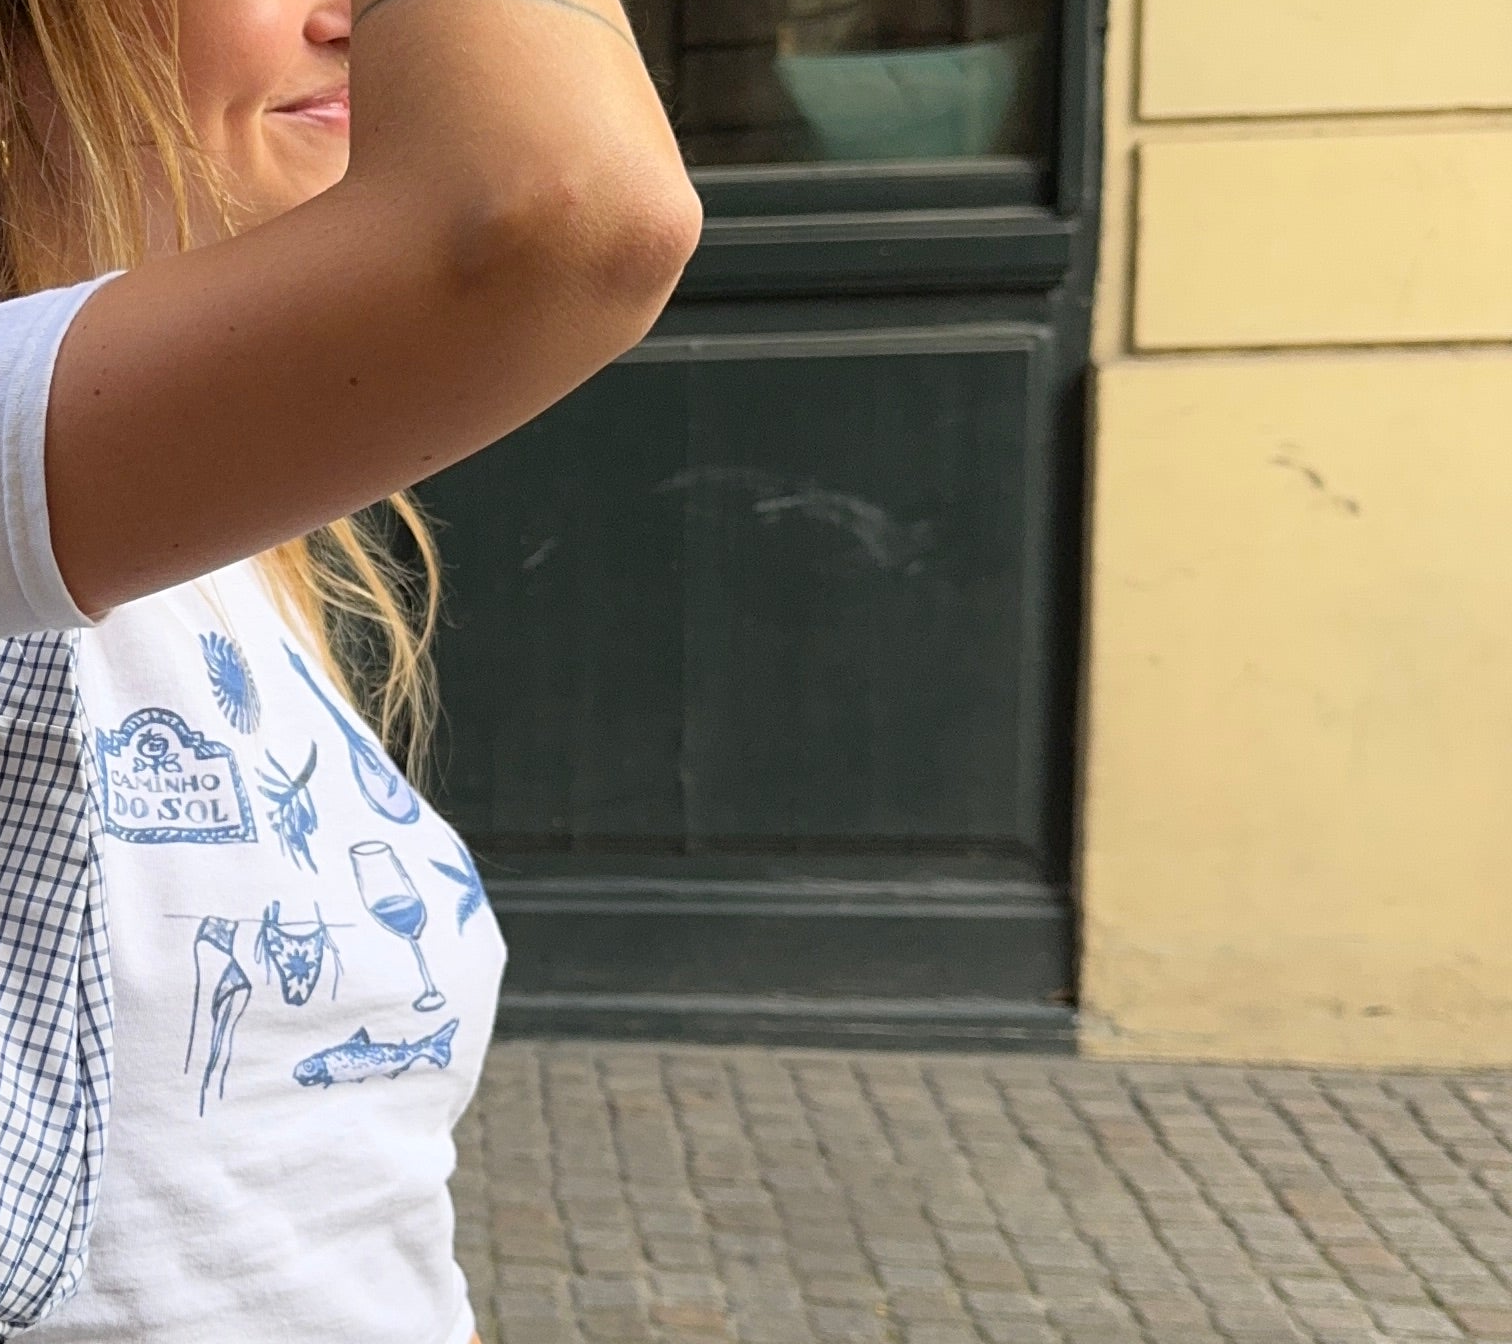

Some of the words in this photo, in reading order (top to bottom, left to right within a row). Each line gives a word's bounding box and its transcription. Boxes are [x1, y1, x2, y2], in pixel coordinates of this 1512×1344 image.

[111, 770, 220, 793] CAMINHO
[114, 790, 149, 818] DO
[157, 797, 229, 823] SOL
